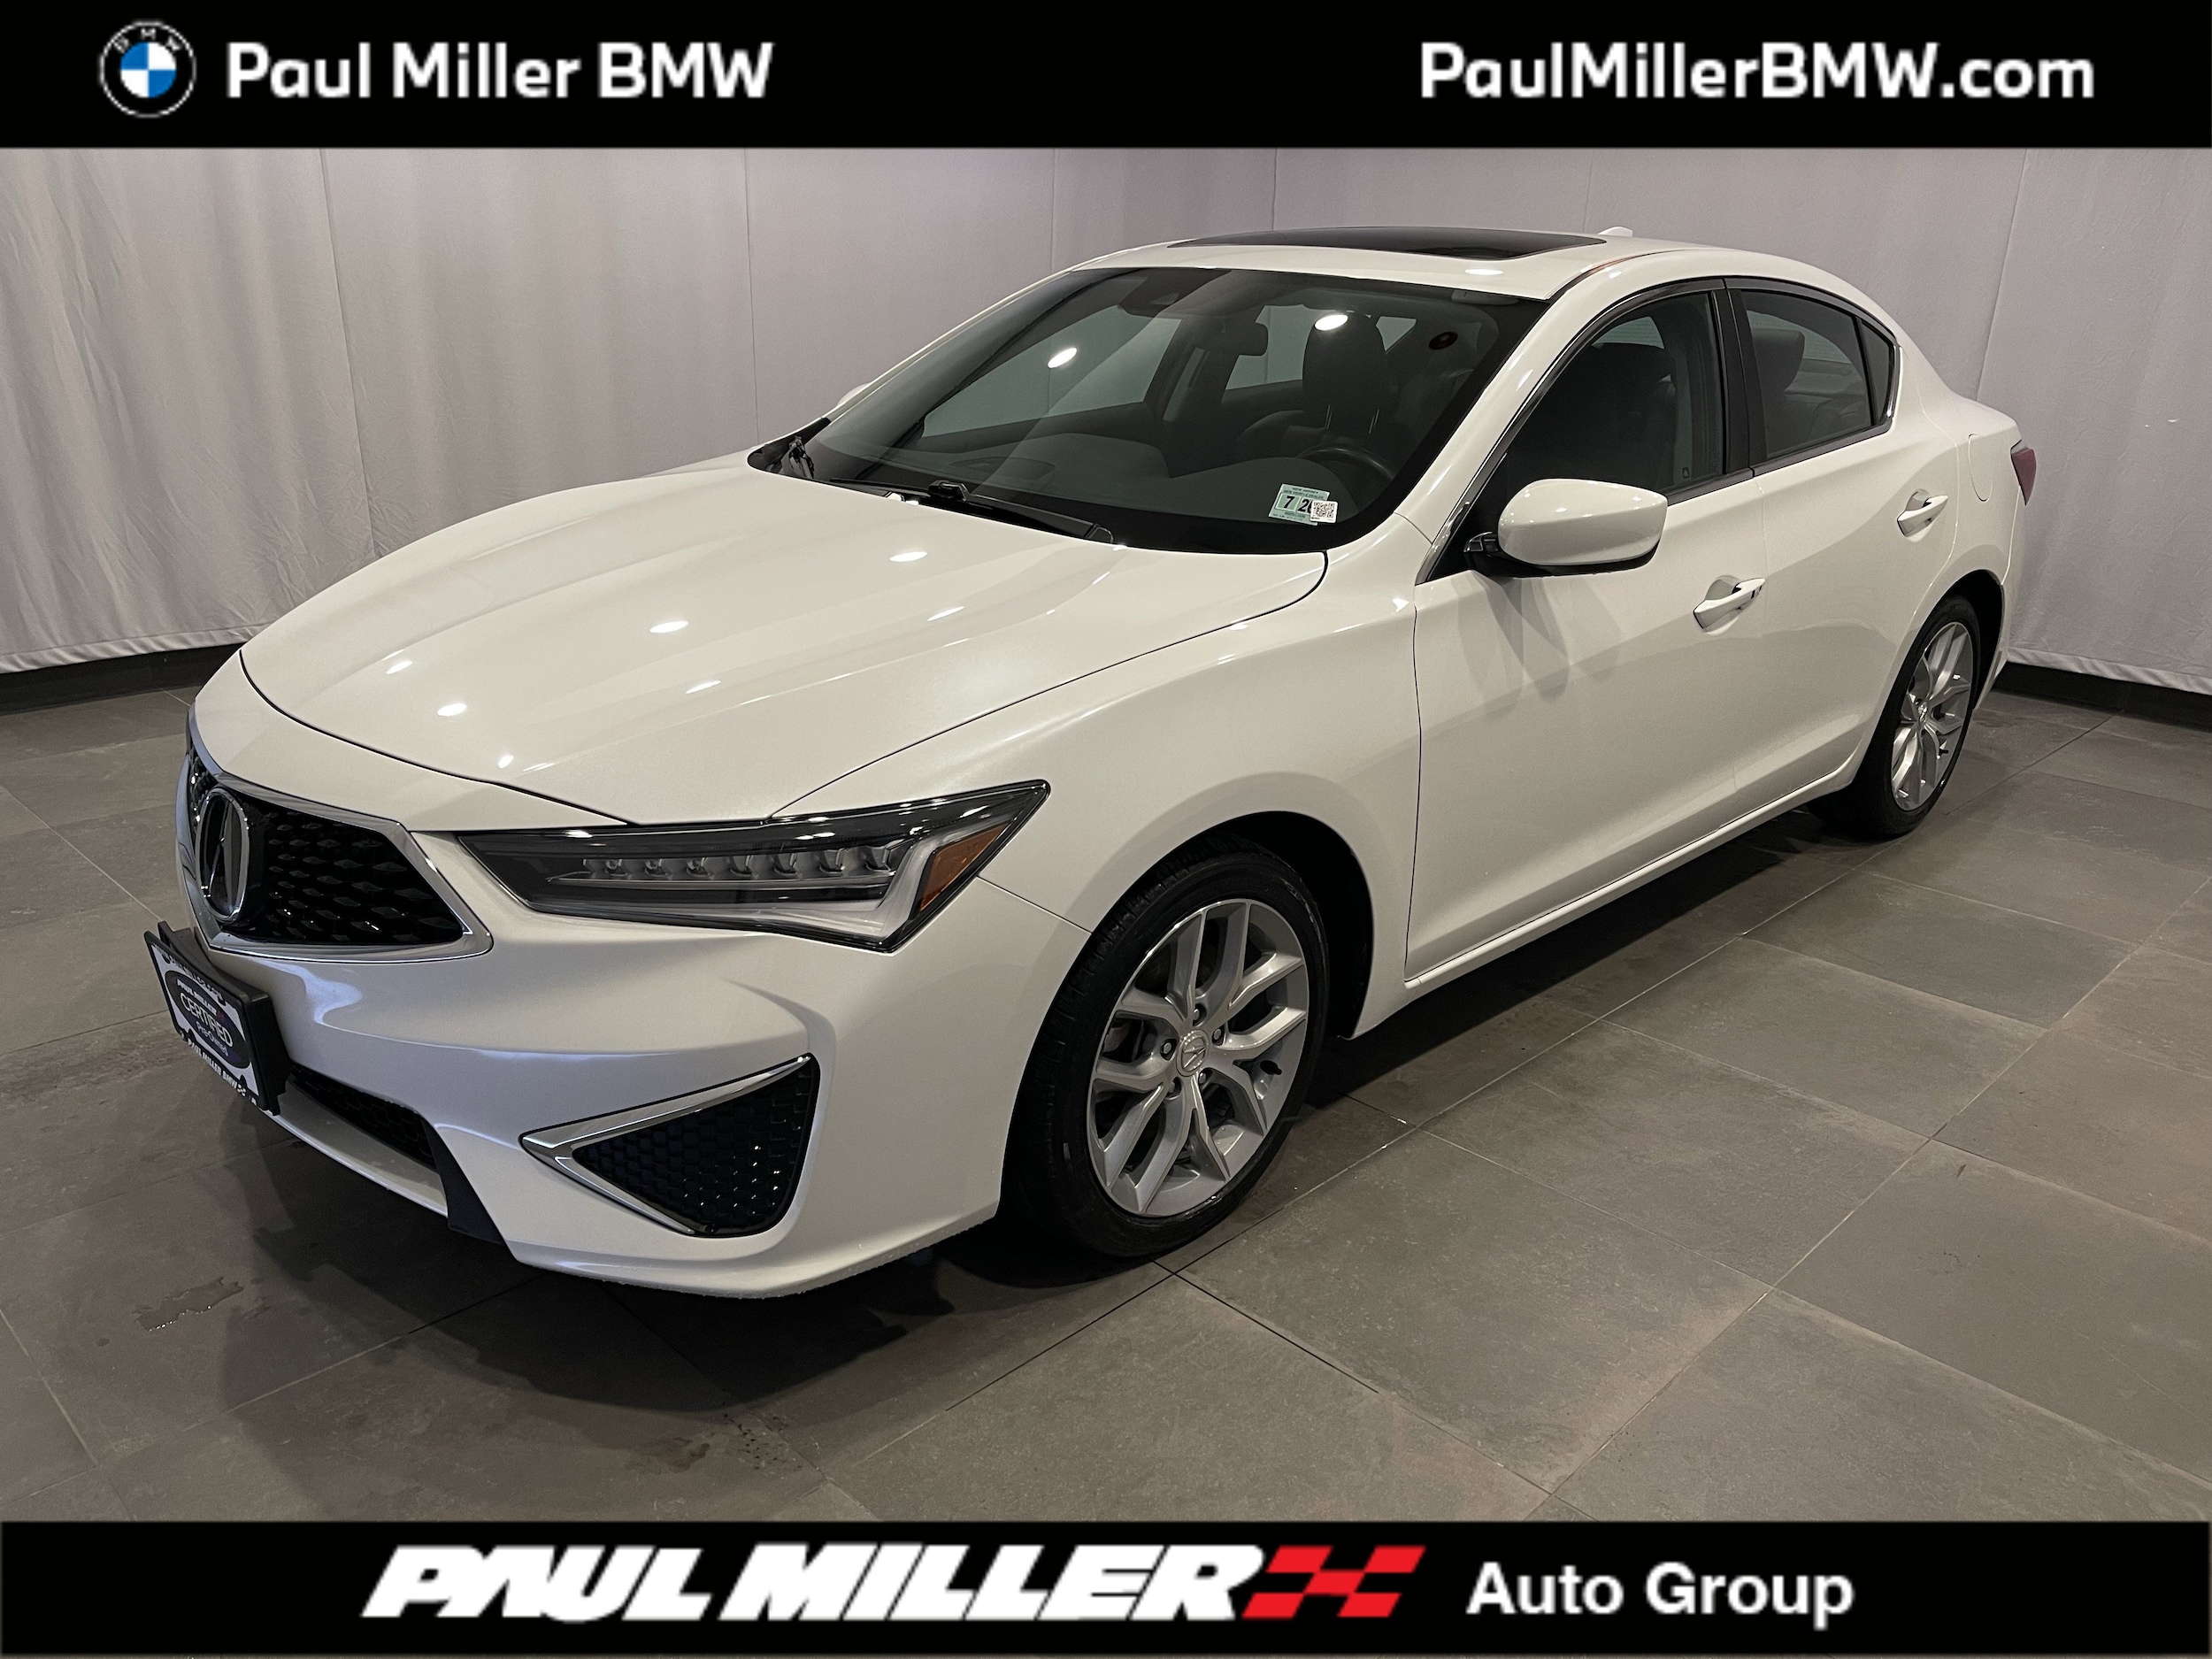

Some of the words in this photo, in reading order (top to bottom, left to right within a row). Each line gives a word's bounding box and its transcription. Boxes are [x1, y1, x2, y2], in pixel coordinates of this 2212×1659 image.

[1284, 495, 1295, 509] 7
[180, 992, 234, 1048] CERTIFIED
[188, 1038, 203, 1057] PAUL
[202, 1051, 222, 1076] MILLER
[222, 1070, 238, 1089] BMW
